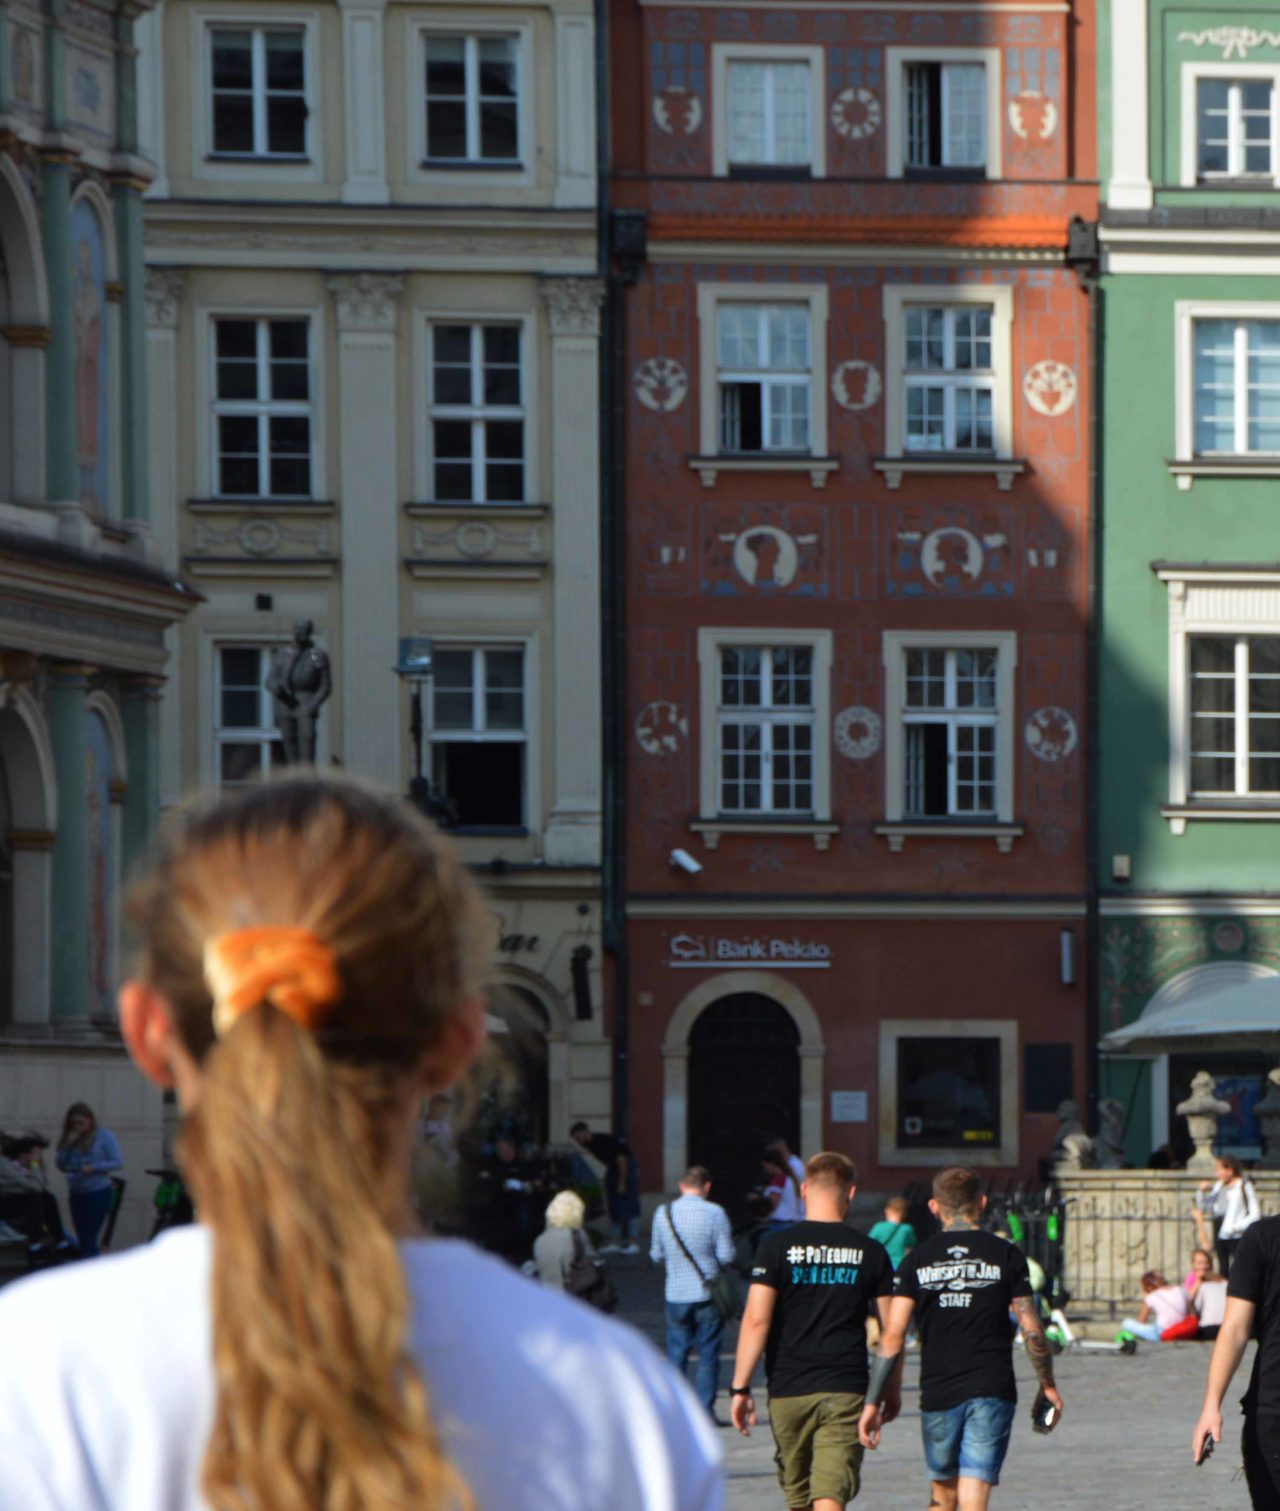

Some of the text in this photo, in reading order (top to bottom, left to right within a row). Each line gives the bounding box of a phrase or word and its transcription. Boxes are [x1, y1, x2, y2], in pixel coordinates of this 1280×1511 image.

[717, 938, 831, 959] Bank Pekao
[976, 1262, 1001, 1281] JAR
[939, 1293, 973, 1308] STAFF
